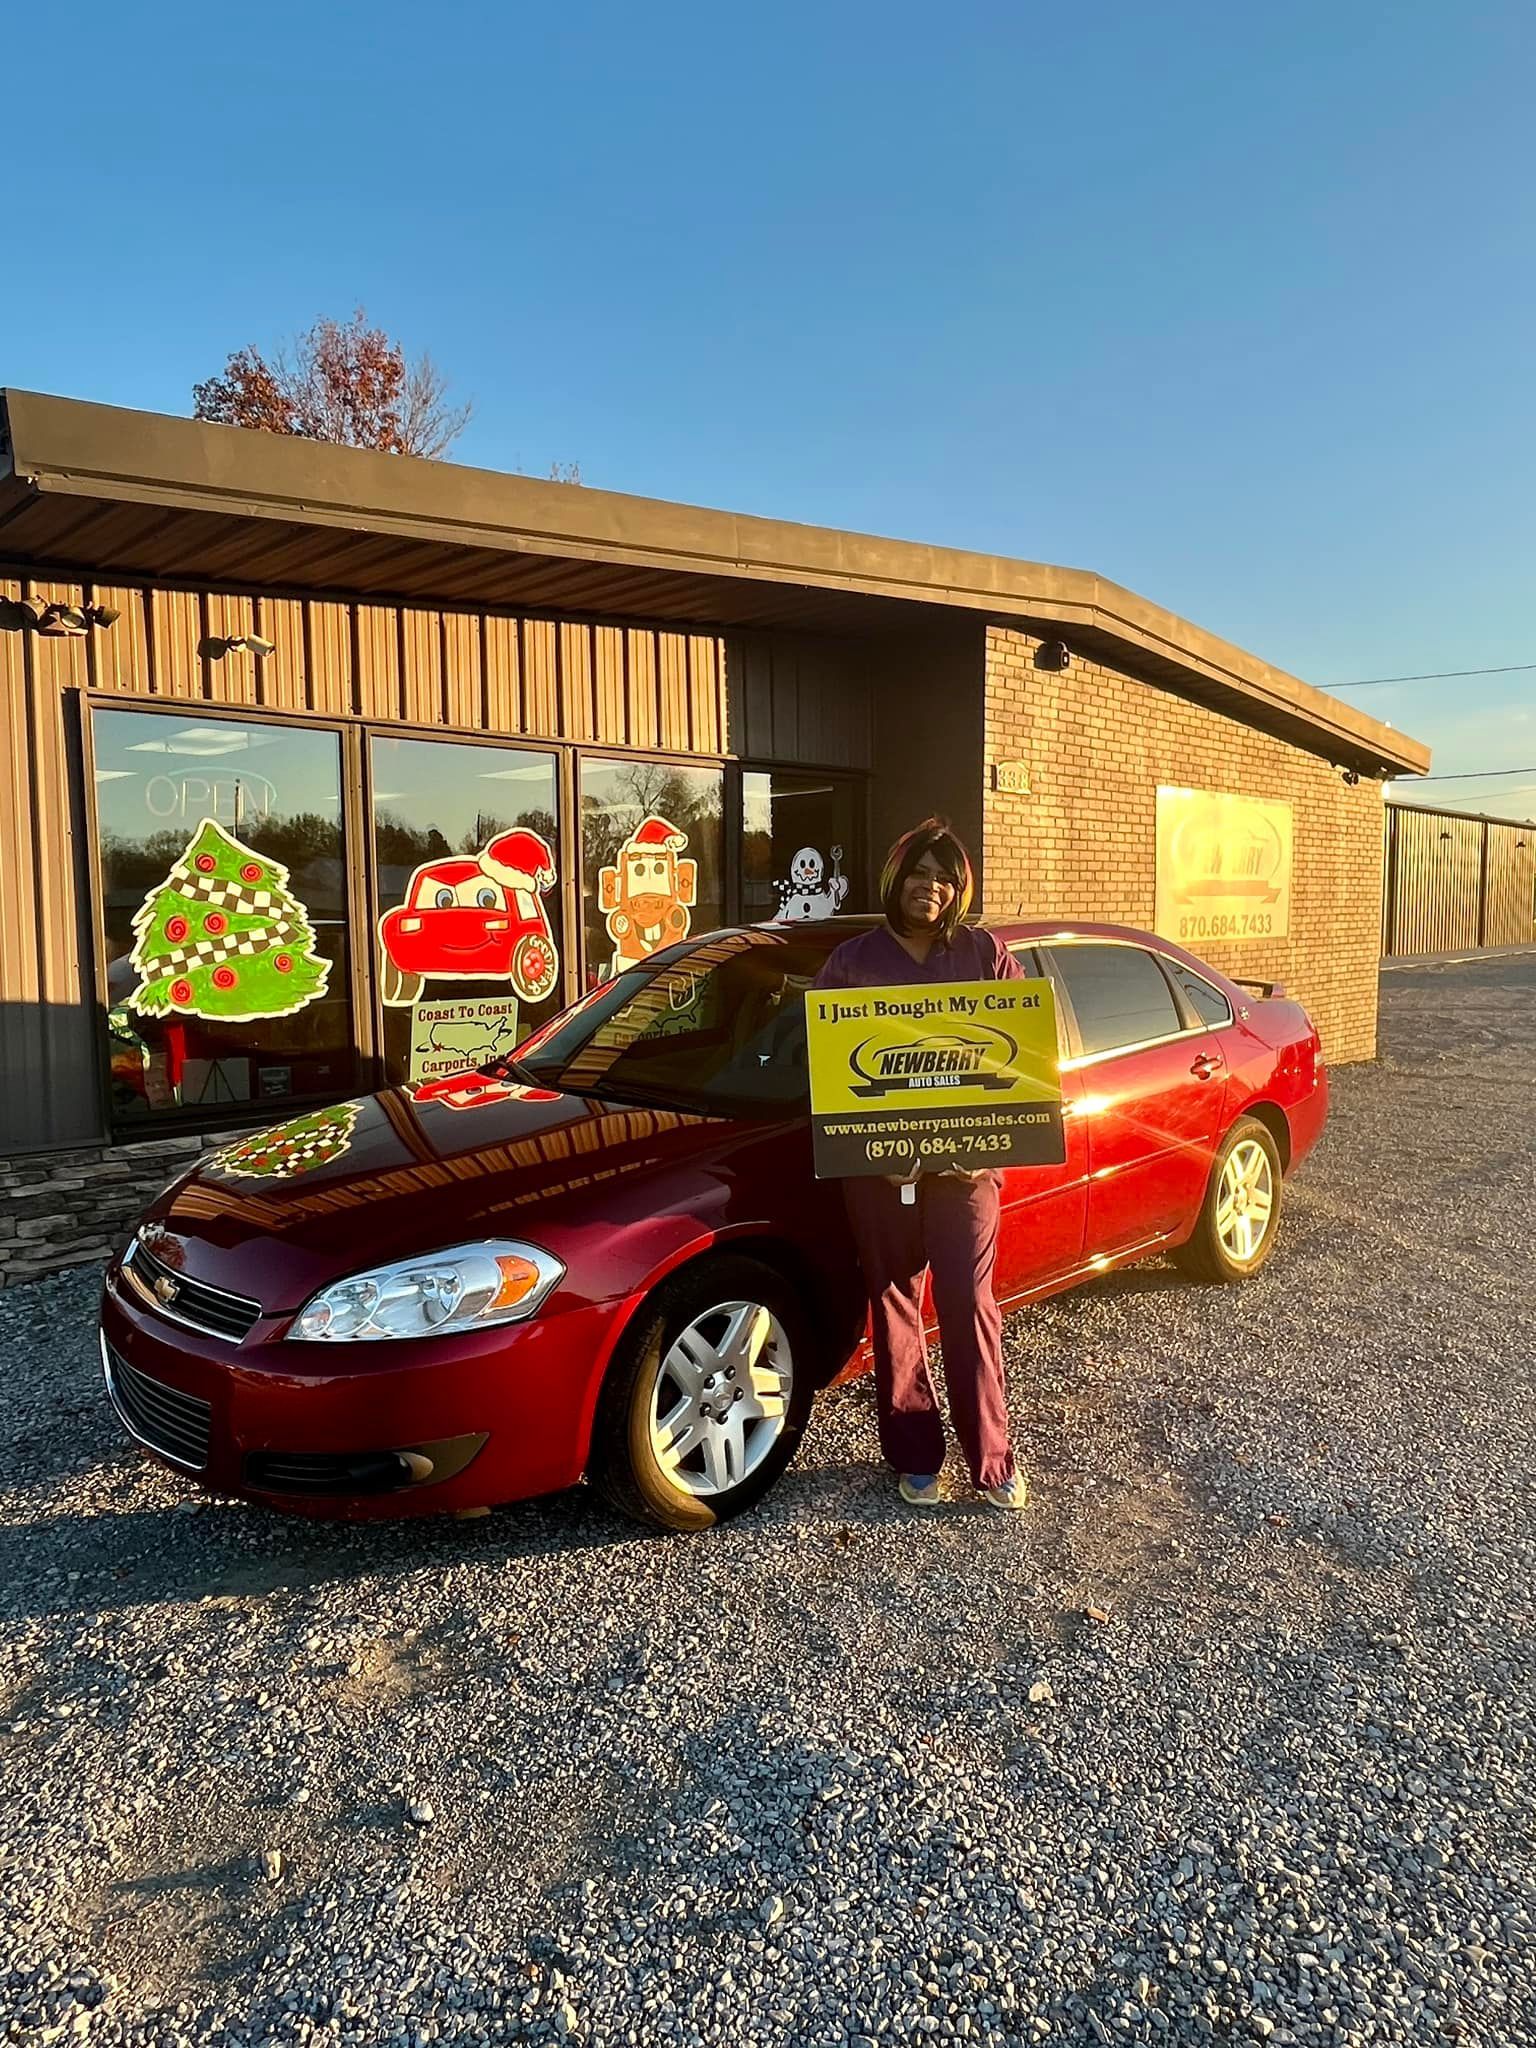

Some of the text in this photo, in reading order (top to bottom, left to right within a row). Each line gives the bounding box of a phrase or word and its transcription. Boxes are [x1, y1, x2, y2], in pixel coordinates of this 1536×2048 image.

[145, 775, 269, 821] OPEN
[1179, 913, 1272, 938] 870.684.7433
[527, 934, 554, 995] GOODYEAR
[418, 1003, 512, 1022] Coast To Coast
[819, 994, 1040, 1023] I Just Bought My Car at
[880, 1048, 985, 1075] NEWBERRY
[908, 1075, 960, 1088] AUTO SALES
[823, 1113, 1050, 1135] www.newberryautosales.com
[865, 1134, 1011, 1160] (870) 684-7433
